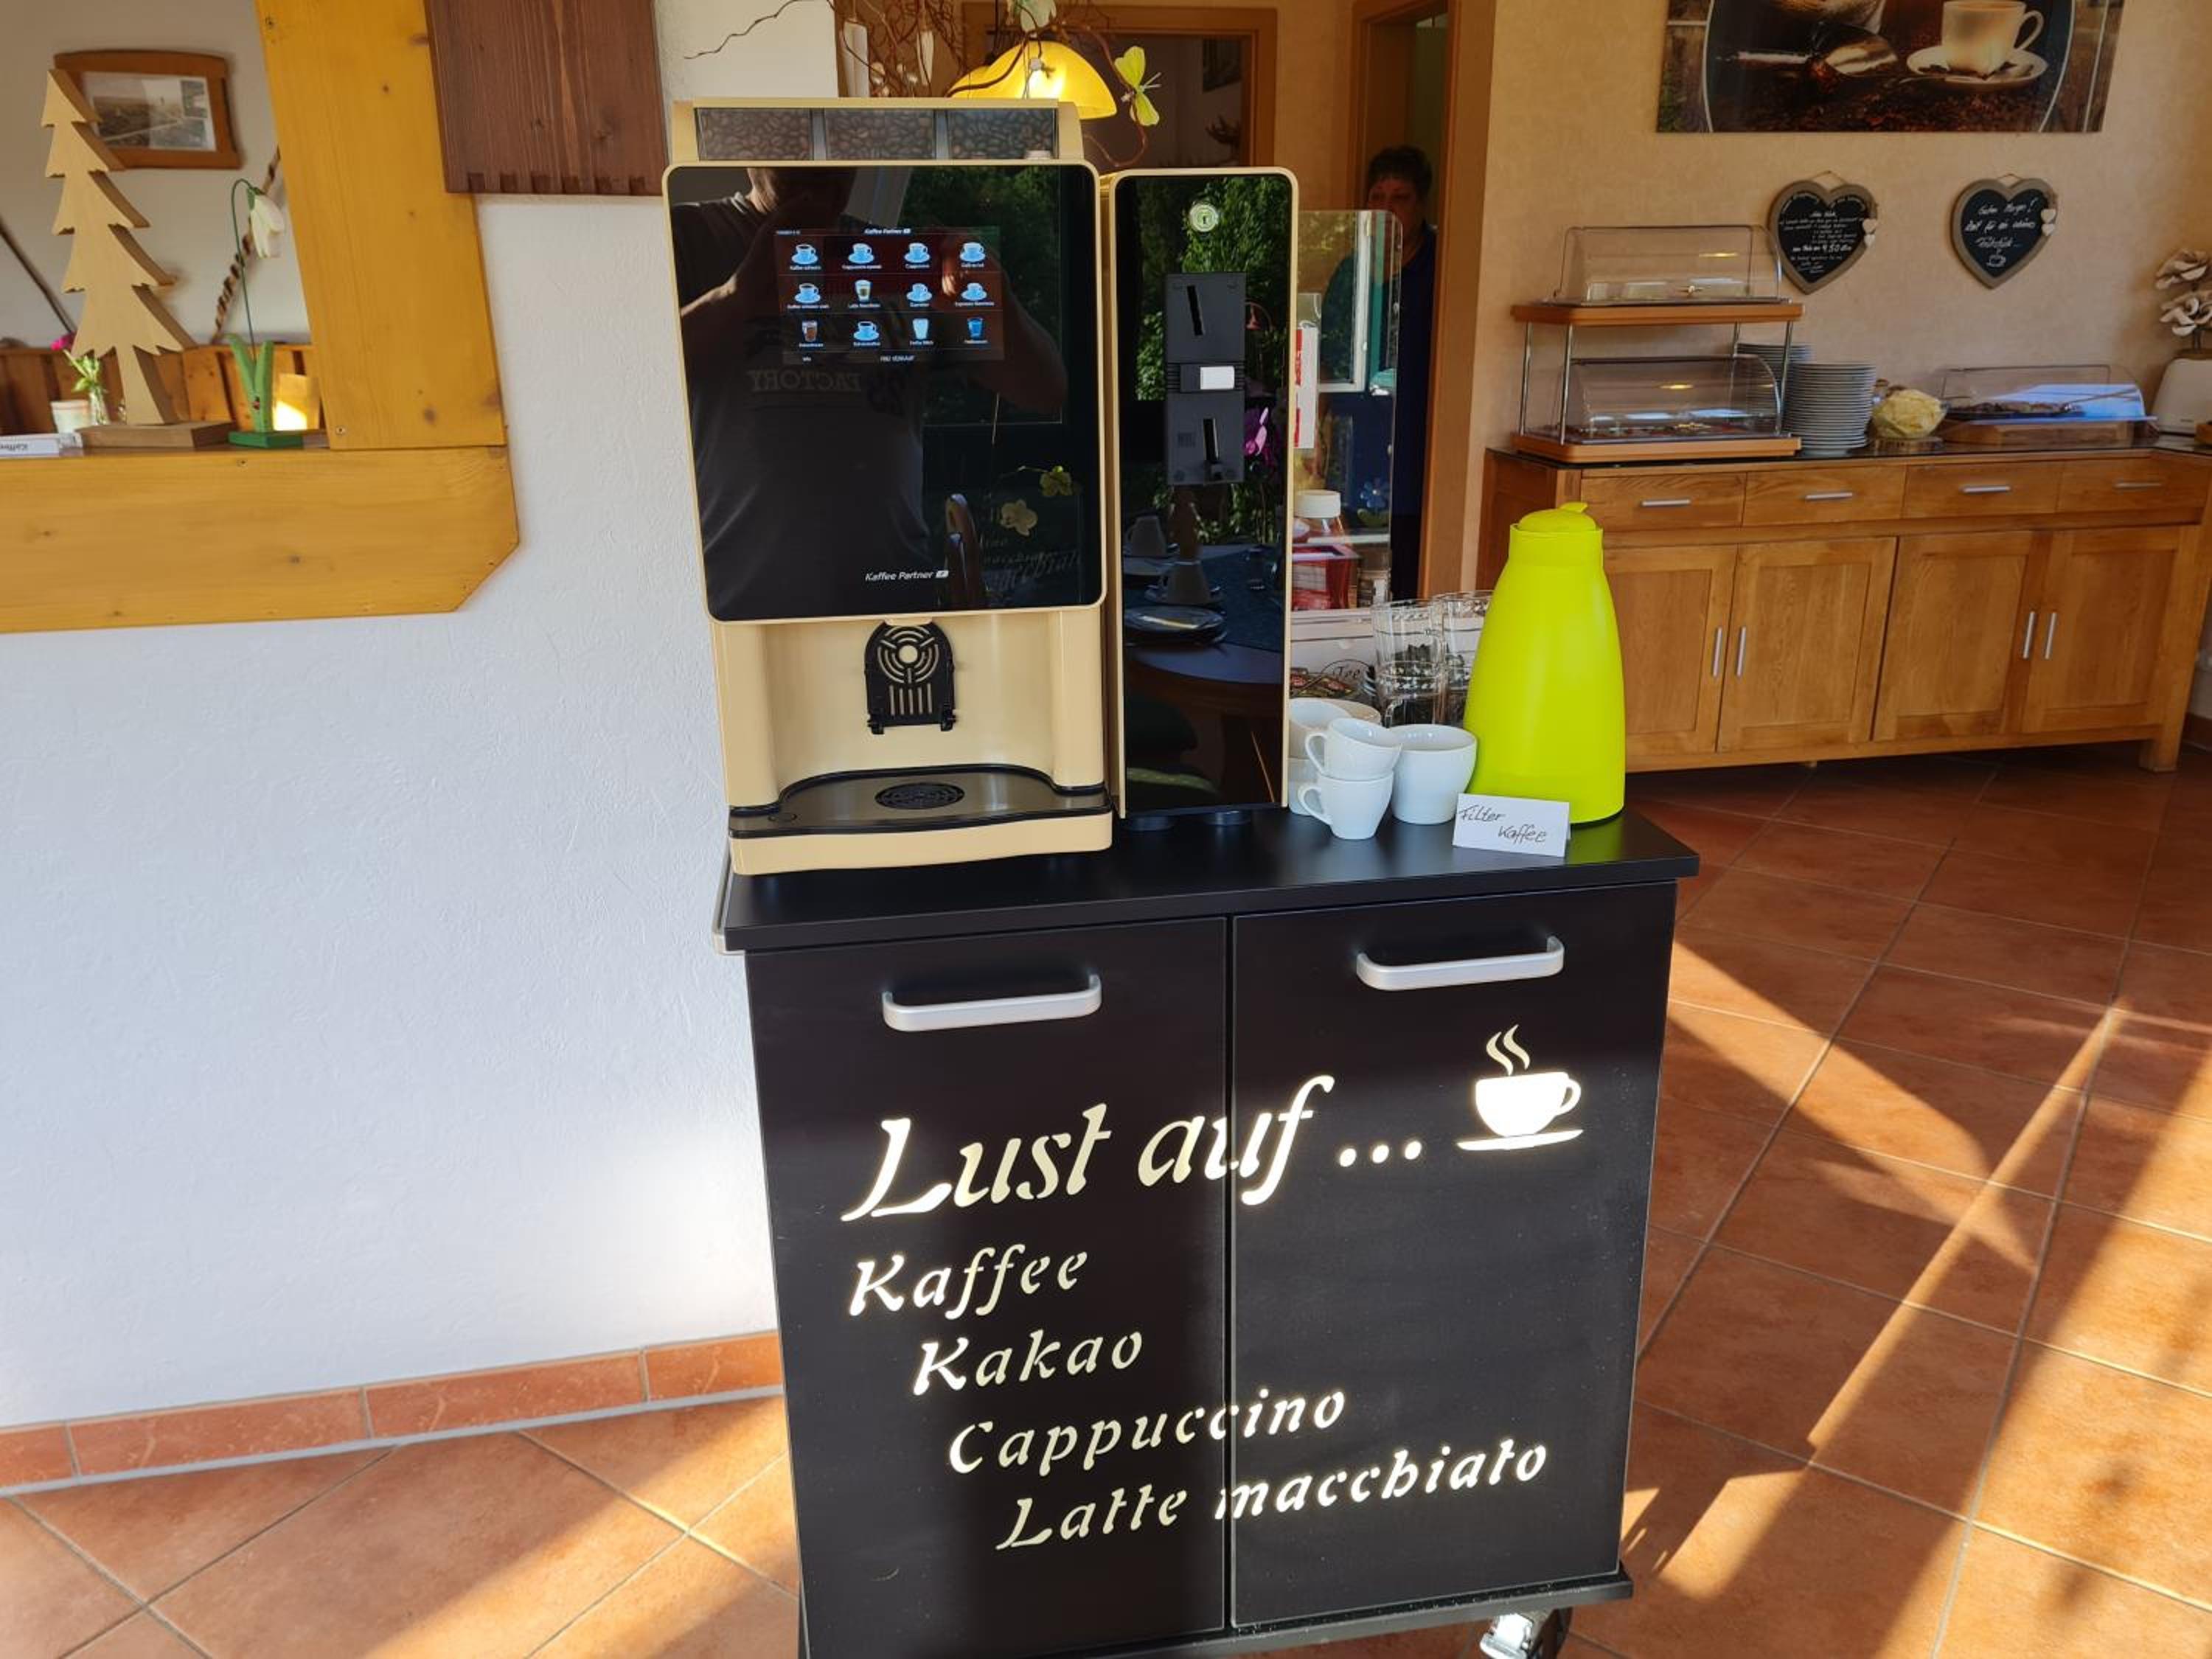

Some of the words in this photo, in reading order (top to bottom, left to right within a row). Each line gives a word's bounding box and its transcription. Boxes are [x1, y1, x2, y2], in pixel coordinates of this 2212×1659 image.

[864, 571, 897, 582] Kaffee
[897, 570, 934, 580] Partner
[1458, 804, 1506, 823] Filter
[840, 1102, 1112, 1222] Lust
[1137, 1074, 1335, 1206] auf
[848, 1244, 1088, 1320] Kaffee
[912, 1329, 1143, 1396] Kakao
[948, 1388, 1346, 1477] Cappuccino
[995, 1484, 1187, 1551] Latte
[1214, 1439, 1548, 1531] macchiato
